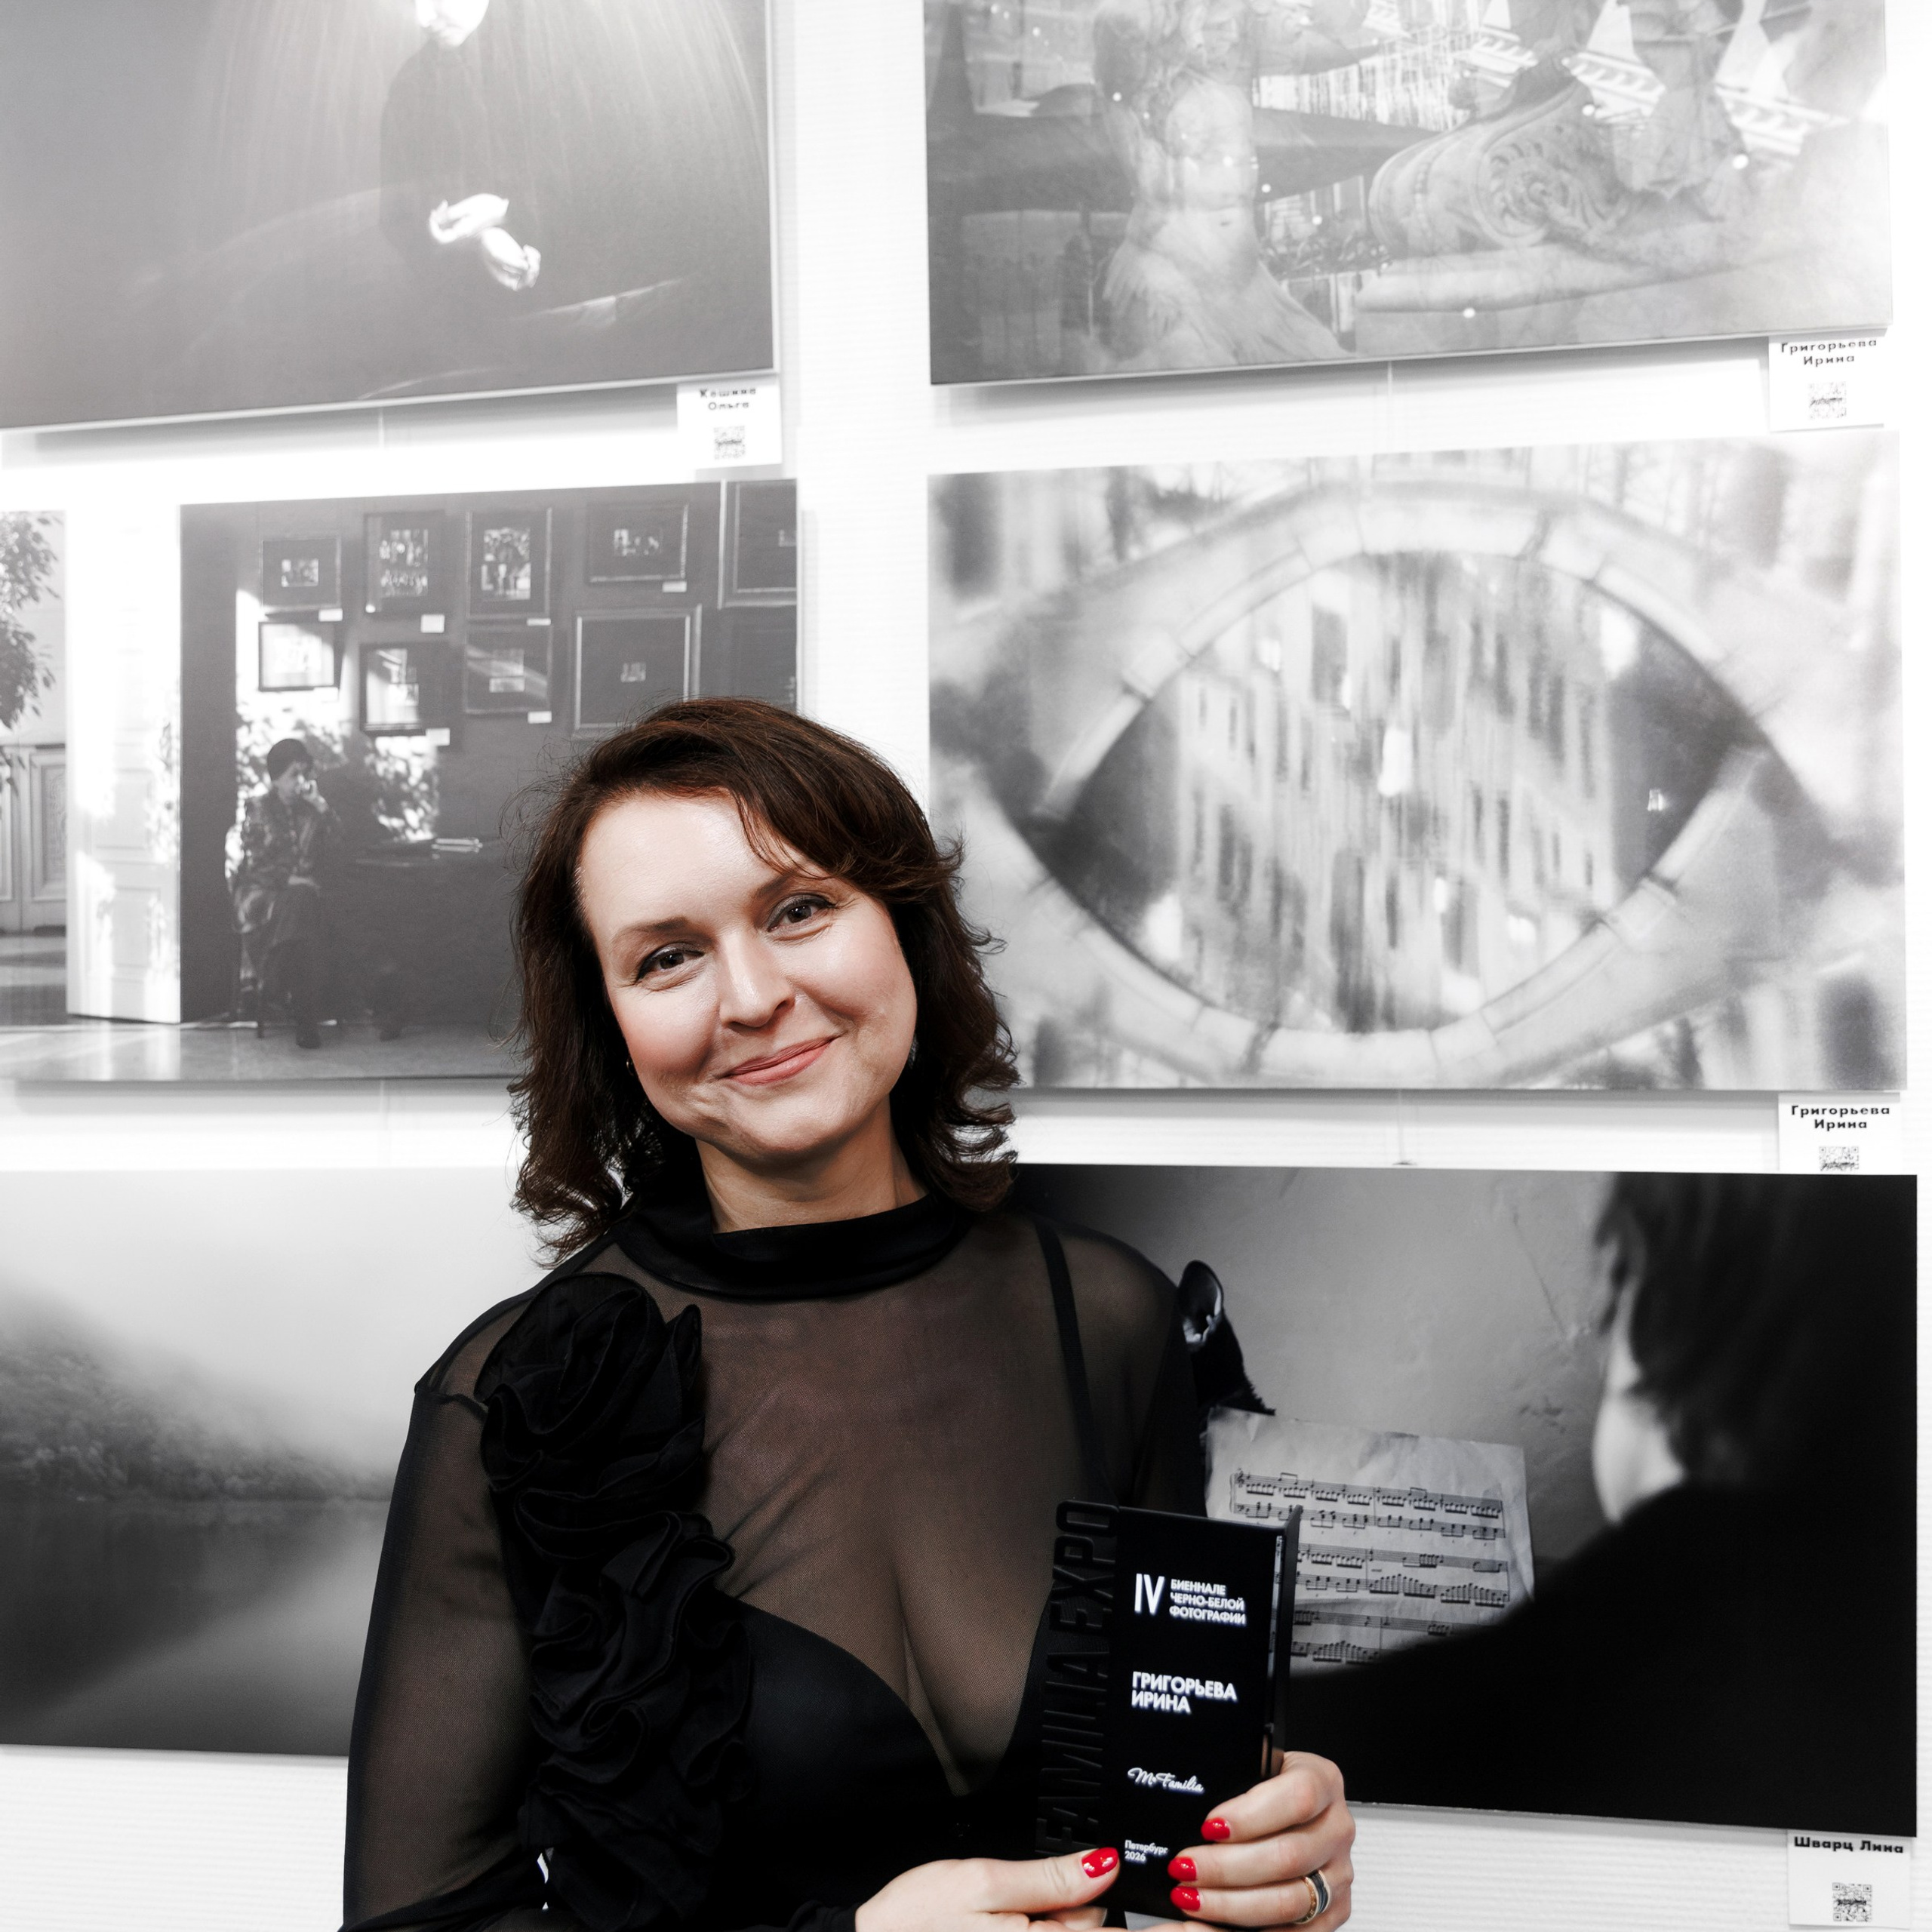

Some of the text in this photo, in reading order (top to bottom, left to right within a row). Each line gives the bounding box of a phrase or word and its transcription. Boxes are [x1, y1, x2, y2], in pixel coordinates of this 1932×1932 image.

[1781, 340, 1877, 355] Григорьева
[1804, 355, 1854, 368] Ирина
[1791, 1105, 1890, 1118] Григорьева
[1814, 1118, 1868, 1131] Ирина
[1049, 1500, 1120, 1635] EXPO
[1134, 1573, 1165, 1615] IV
[1171, 1579, 1226, 1596] БИЕННАЛЕ
[1170, 1592, 1245, 1611] ЧЕРНО-БЕЛОЙ
[1169, 1605, 1247, 1626] ФОТОГРАФИИ
[1132, 1671, 1238, 1701] ГРИГОРЬЕВА
[1131, 1690, 1192, 1715] ИРИНА
[1124, 1839, 1168, 1856] Петербург
[1794, 1836, 1904, 1854] Шварц Лина
[1124, 1850, 1146, 1863] 2026
